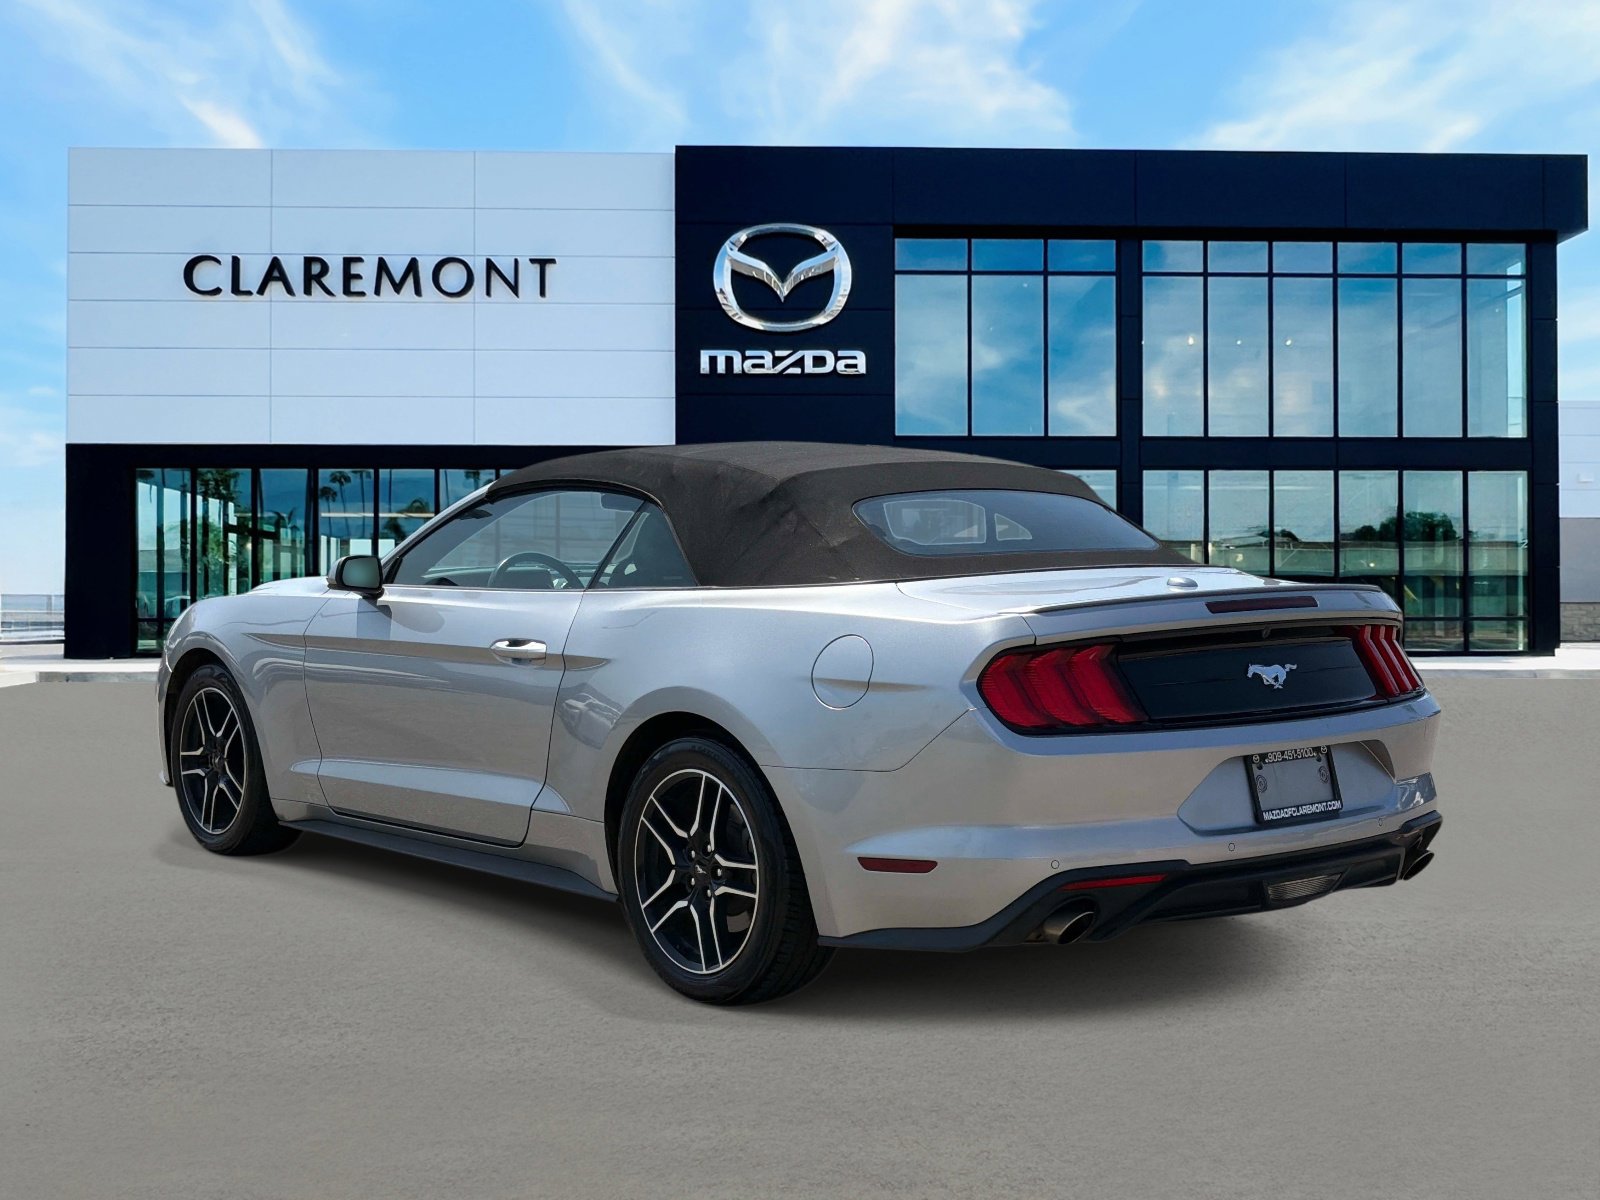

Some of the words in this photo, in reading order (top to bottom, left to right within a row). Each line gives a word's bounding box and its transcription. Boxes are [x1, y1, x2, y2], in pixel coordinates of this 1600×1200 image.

[183, 254, 557, 299] CLAREMONT
[699, 349, 867, 375] mazda
[1262, 800, 1342, 821] MAZDAOFCLAREMONT.COM
